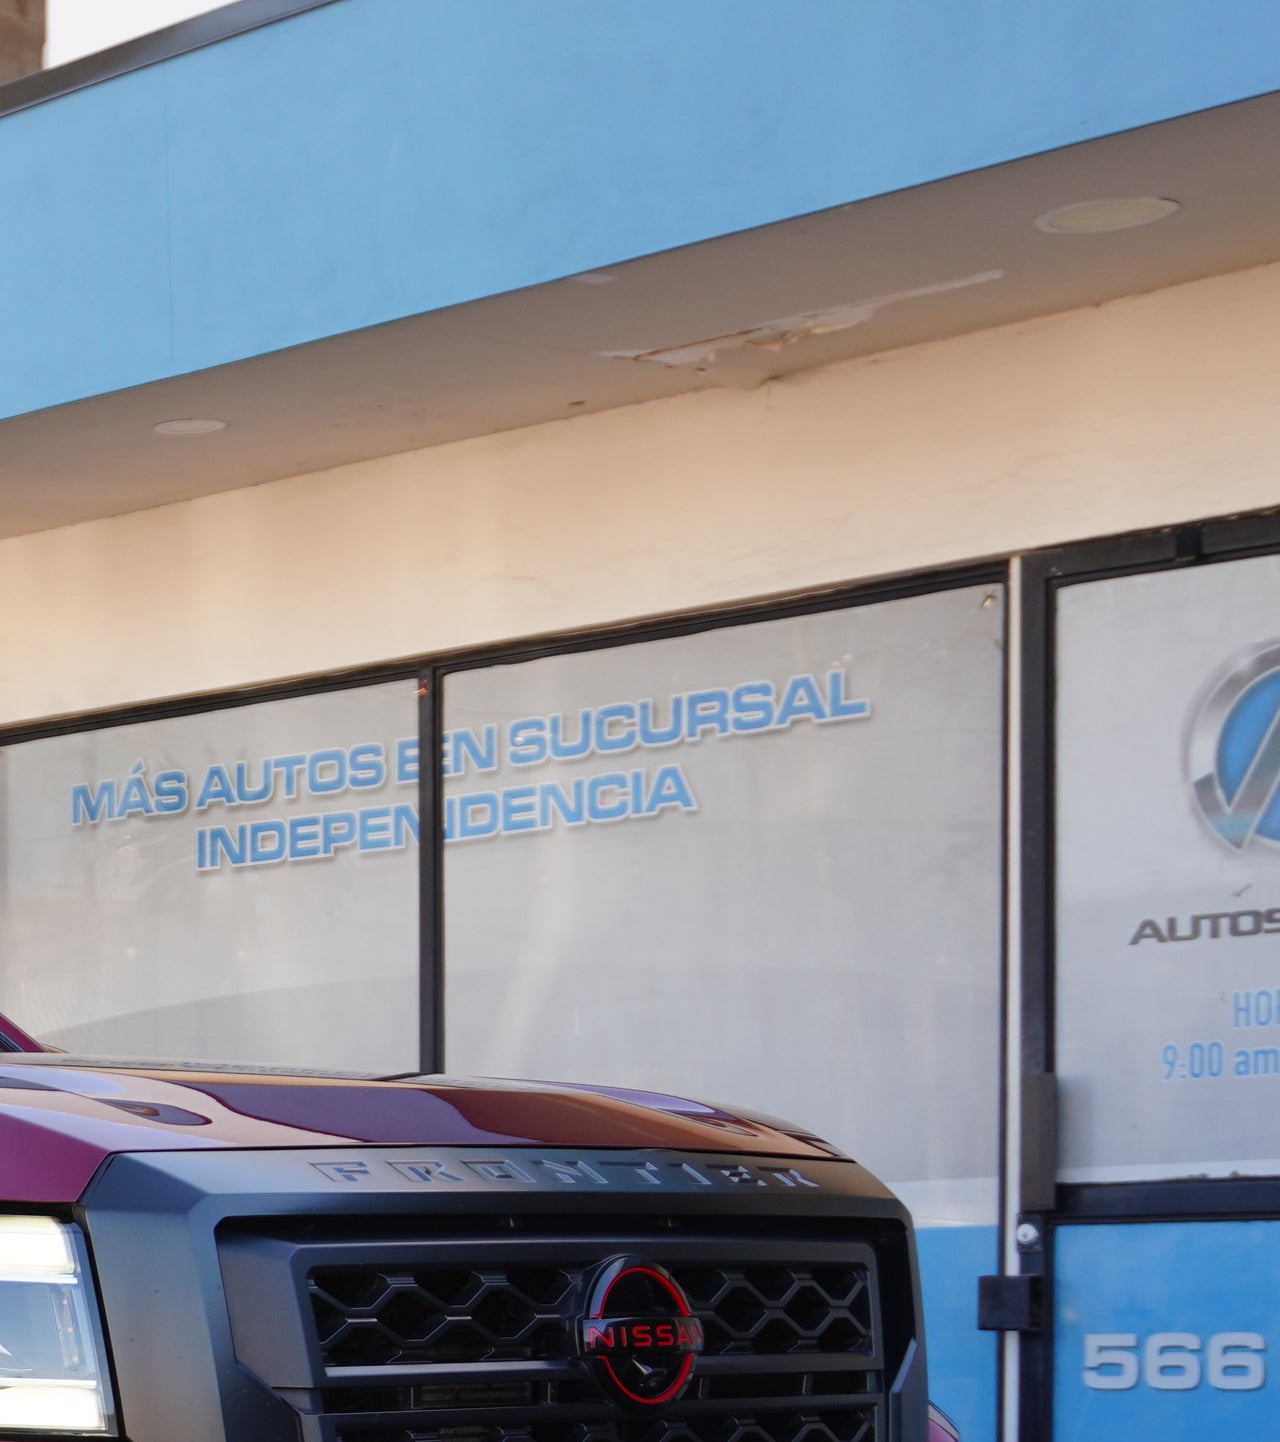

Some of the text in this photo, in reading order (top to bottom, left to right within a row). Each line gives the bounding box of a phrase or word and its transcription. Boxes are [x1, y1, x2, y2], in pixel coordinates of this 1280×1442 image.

[72, 669, 871, 826] MÁS AUTOS EN SUCURSAL
[196, 763, 698, 871] INDEPENDENCIA
[1232, 989, 1280, 1028] HO
[1162, 1041, 1280, 1080] 9:00 am
[310, 1160, 821, 1188] FRONTIER
[1083, 1332, 1267, 1390] 566
